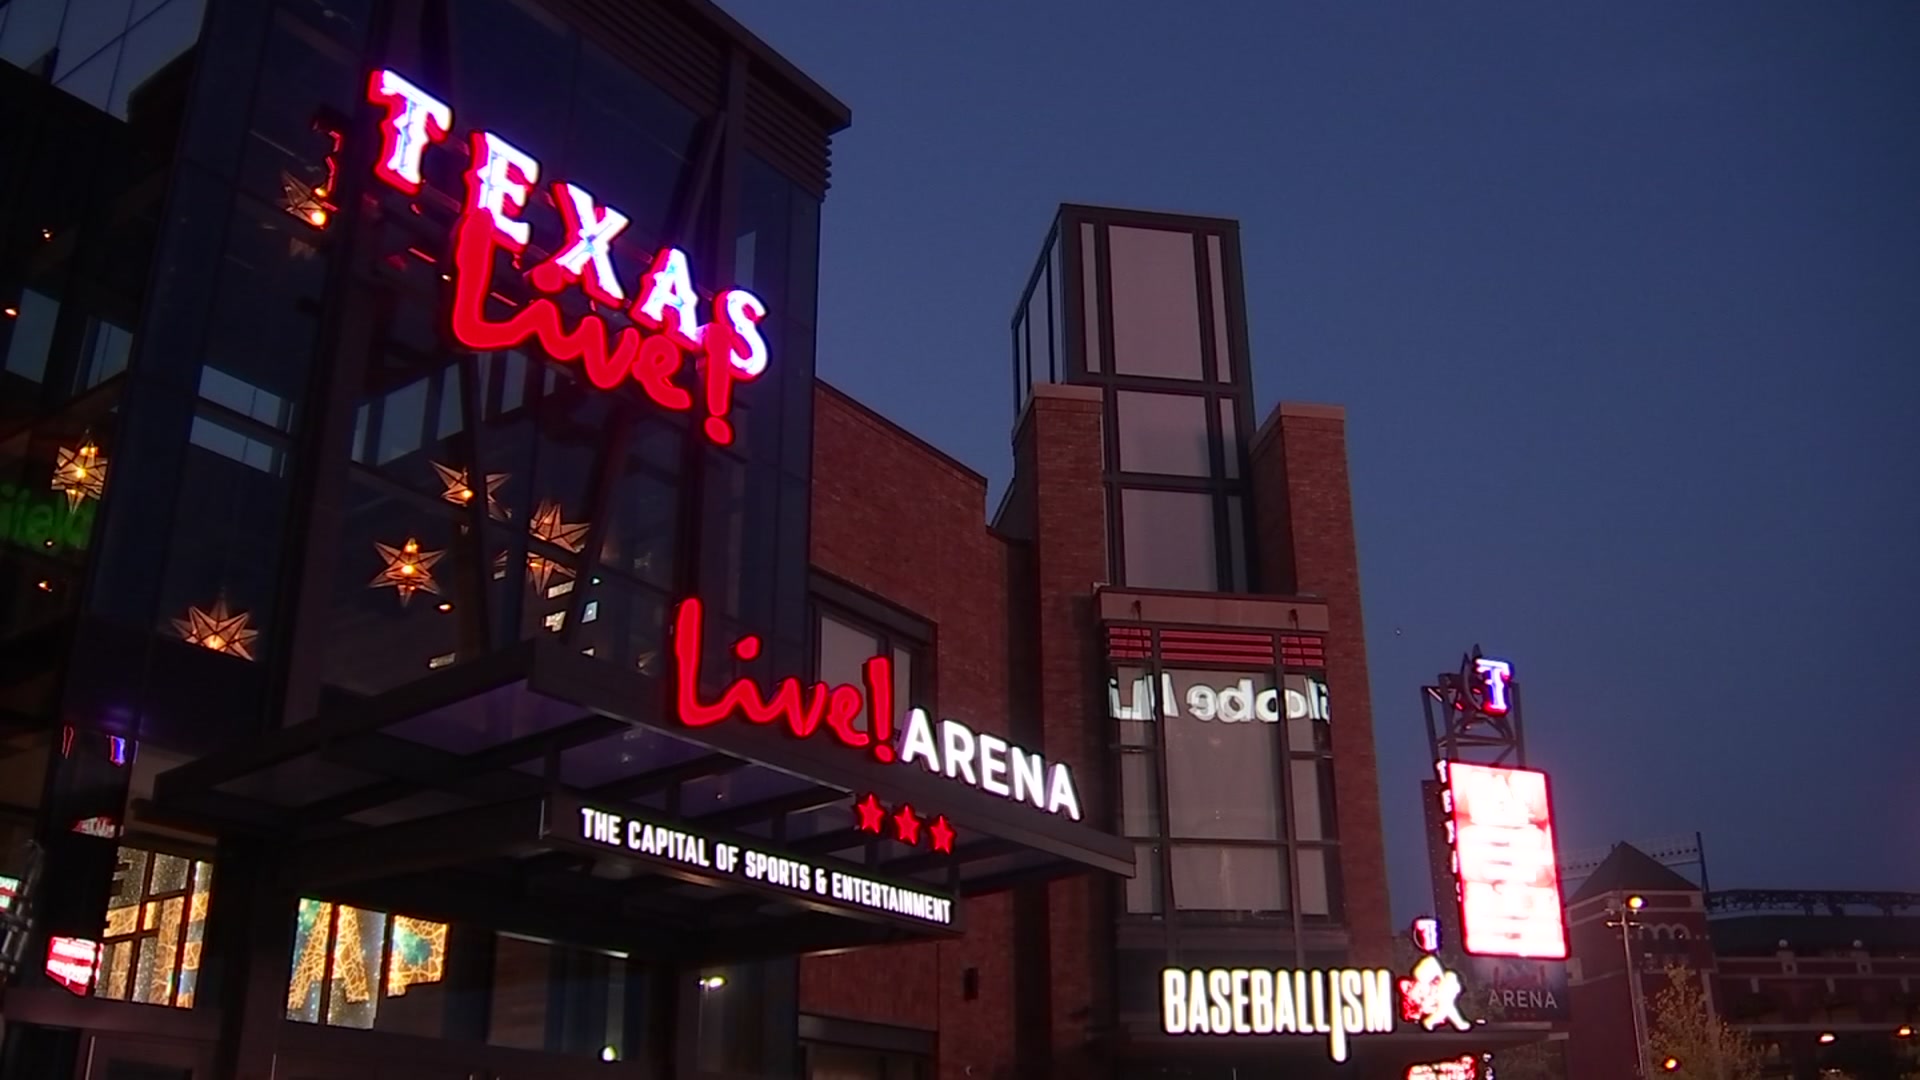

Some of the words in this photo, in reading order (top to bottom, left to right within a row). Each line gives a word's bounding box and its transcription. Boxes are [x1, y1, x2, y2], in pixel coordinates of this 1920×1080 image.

[368, 69, 770, 382] TEXAS
[453, 207, 736, 444] Live!
[672, 597, 897, 763] Live!
[901, 706, 1082, 821] ARENA
[581, 806, 622, 846] THE
[627, 820, 710, 868] CAPITAL
[716, 842, 740, 874] OF
[745, 849, 810, 893] SPORTS
[815, 867, 828, 896] &
[831, 871, 951, 925] ENTERTAINMENT
[1161, 967, 1396, 1063] BASEBALLISM
[1487, 988, 1558, 1010] ARENA
